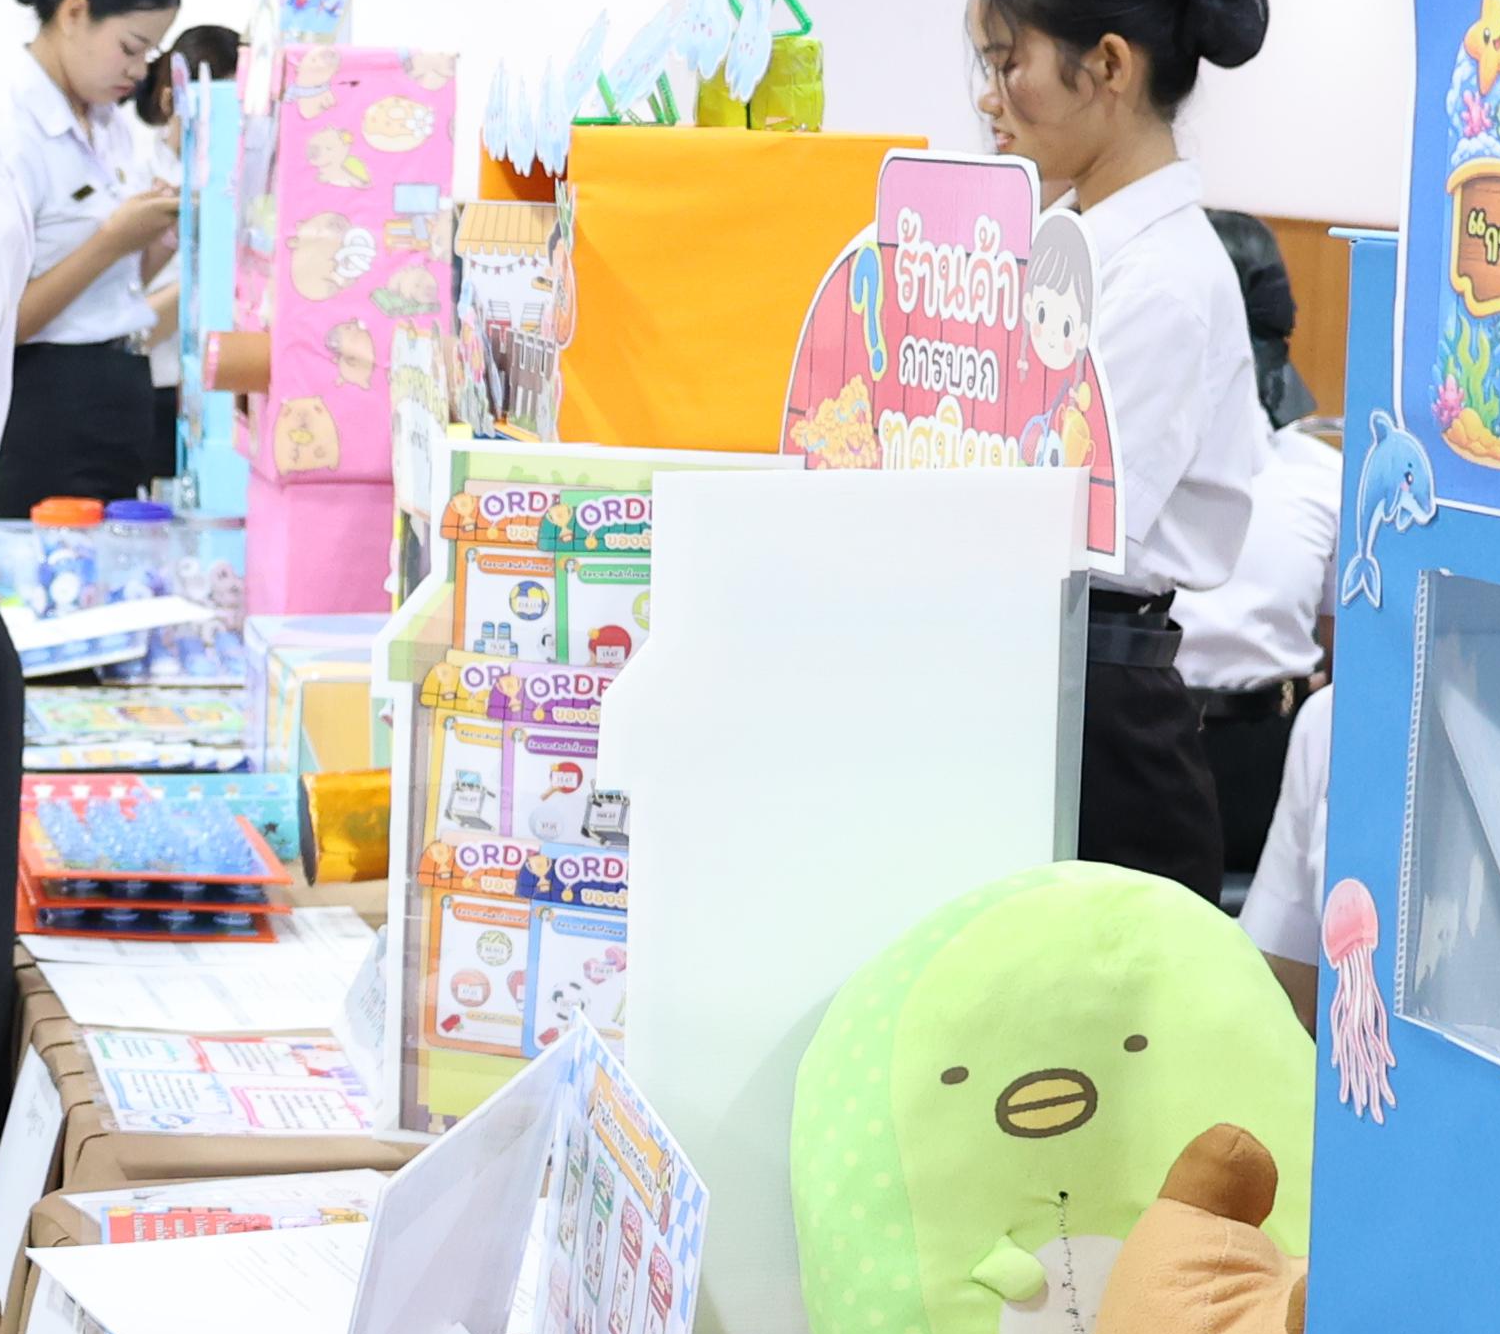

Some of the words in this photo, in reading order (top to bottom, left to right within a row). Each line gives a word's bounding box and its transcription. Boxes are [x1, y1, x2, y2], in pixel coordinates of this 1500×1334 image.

[896, 211, 1020, 330] ร้านค้า
[900, 339, 999, 402] การบวก
[580, 497, 653, 526] ORD
[459, 844, 537, 867] ORD
